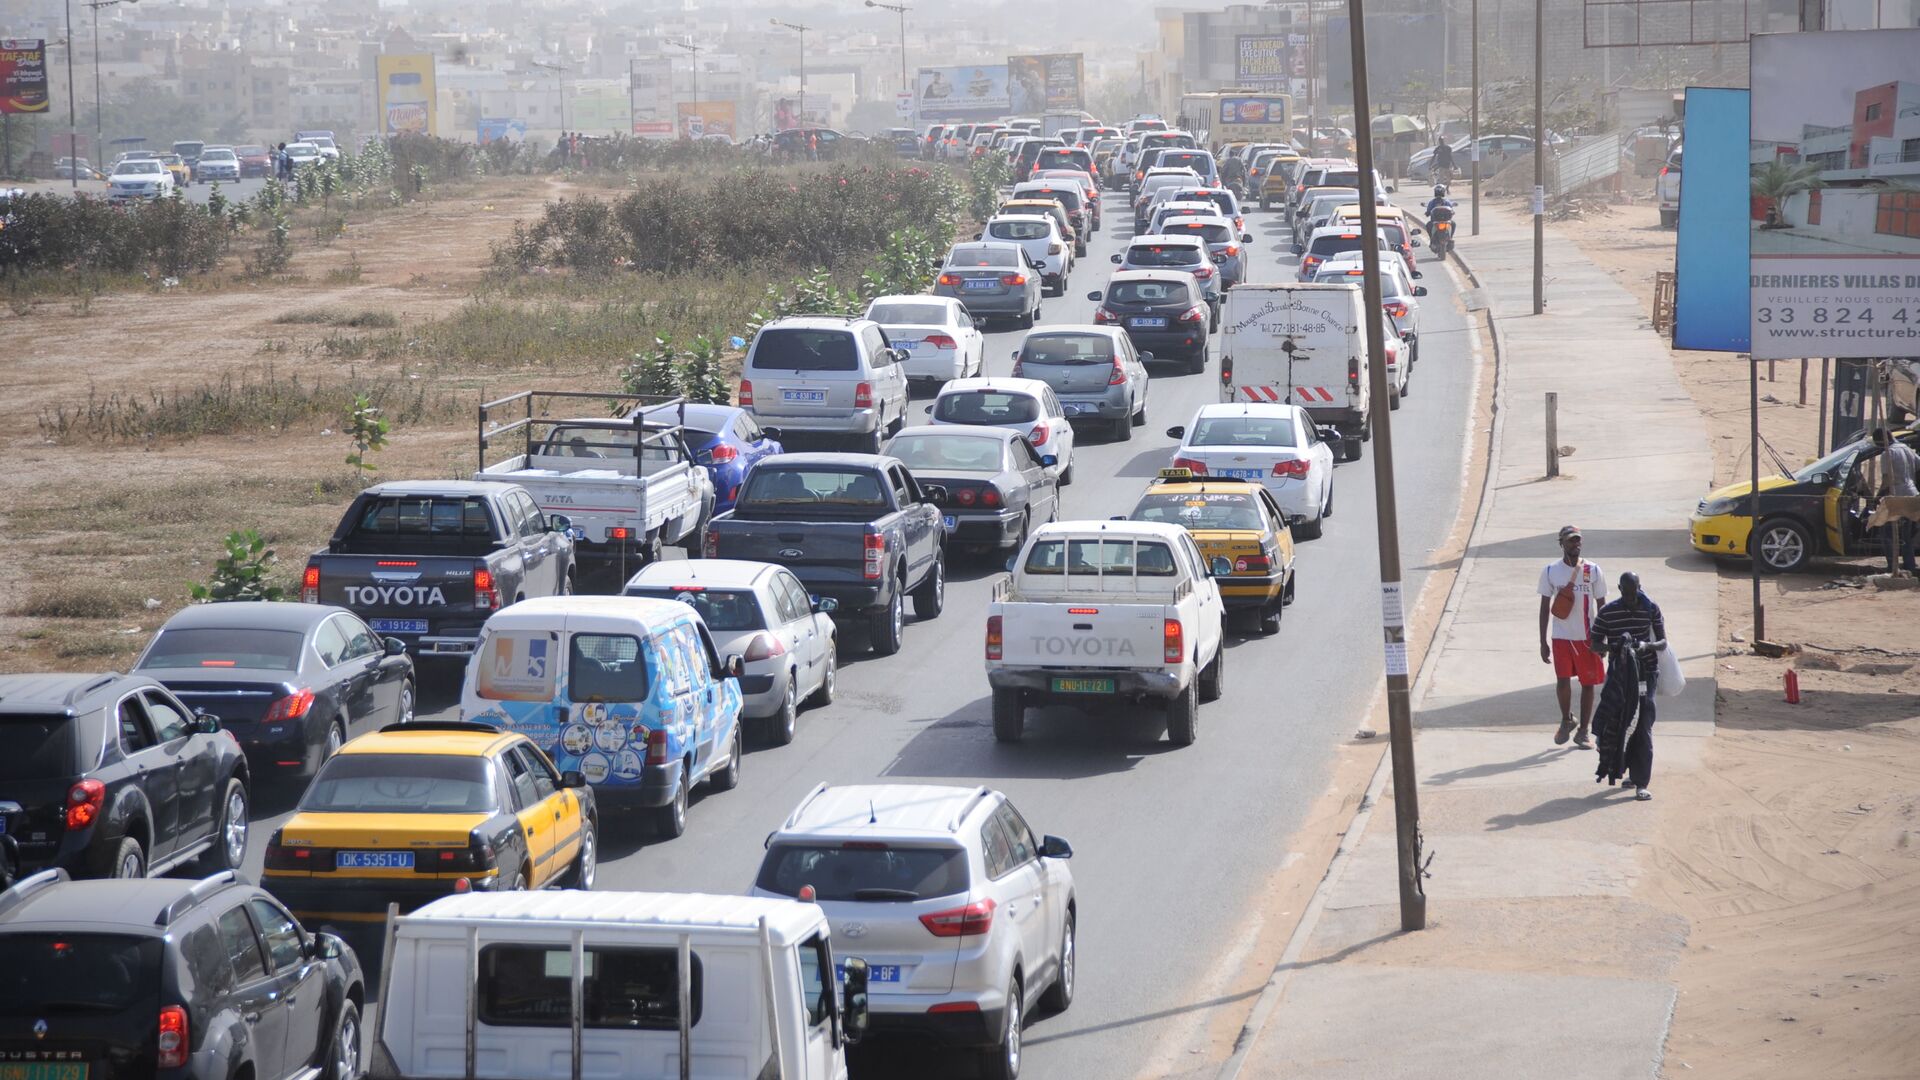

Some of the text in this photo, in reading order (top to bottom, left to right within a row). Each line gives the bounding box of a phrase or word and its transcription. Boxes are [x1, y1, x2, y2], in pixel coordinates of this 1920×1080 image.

[1240, 40, 1251, 49] LES
[1240, 48, 1278, 57] EXECUTIVE
[1240, 65, 1249, 74] ET
[1750, 275, 1839, 288] DERNIERES
[1844, 275, 1900, 288] VILLAS
[1758, 308, 1795, 323] 33
[1813, 308, 1874, 323] 824
[1769, 328, 1920, 338] www.structureb
[545, 495, 574, 503] TATA
[344, 586, 446, 605] TOYOTA
[1030, 636, 1136, 656] TOYOTA
